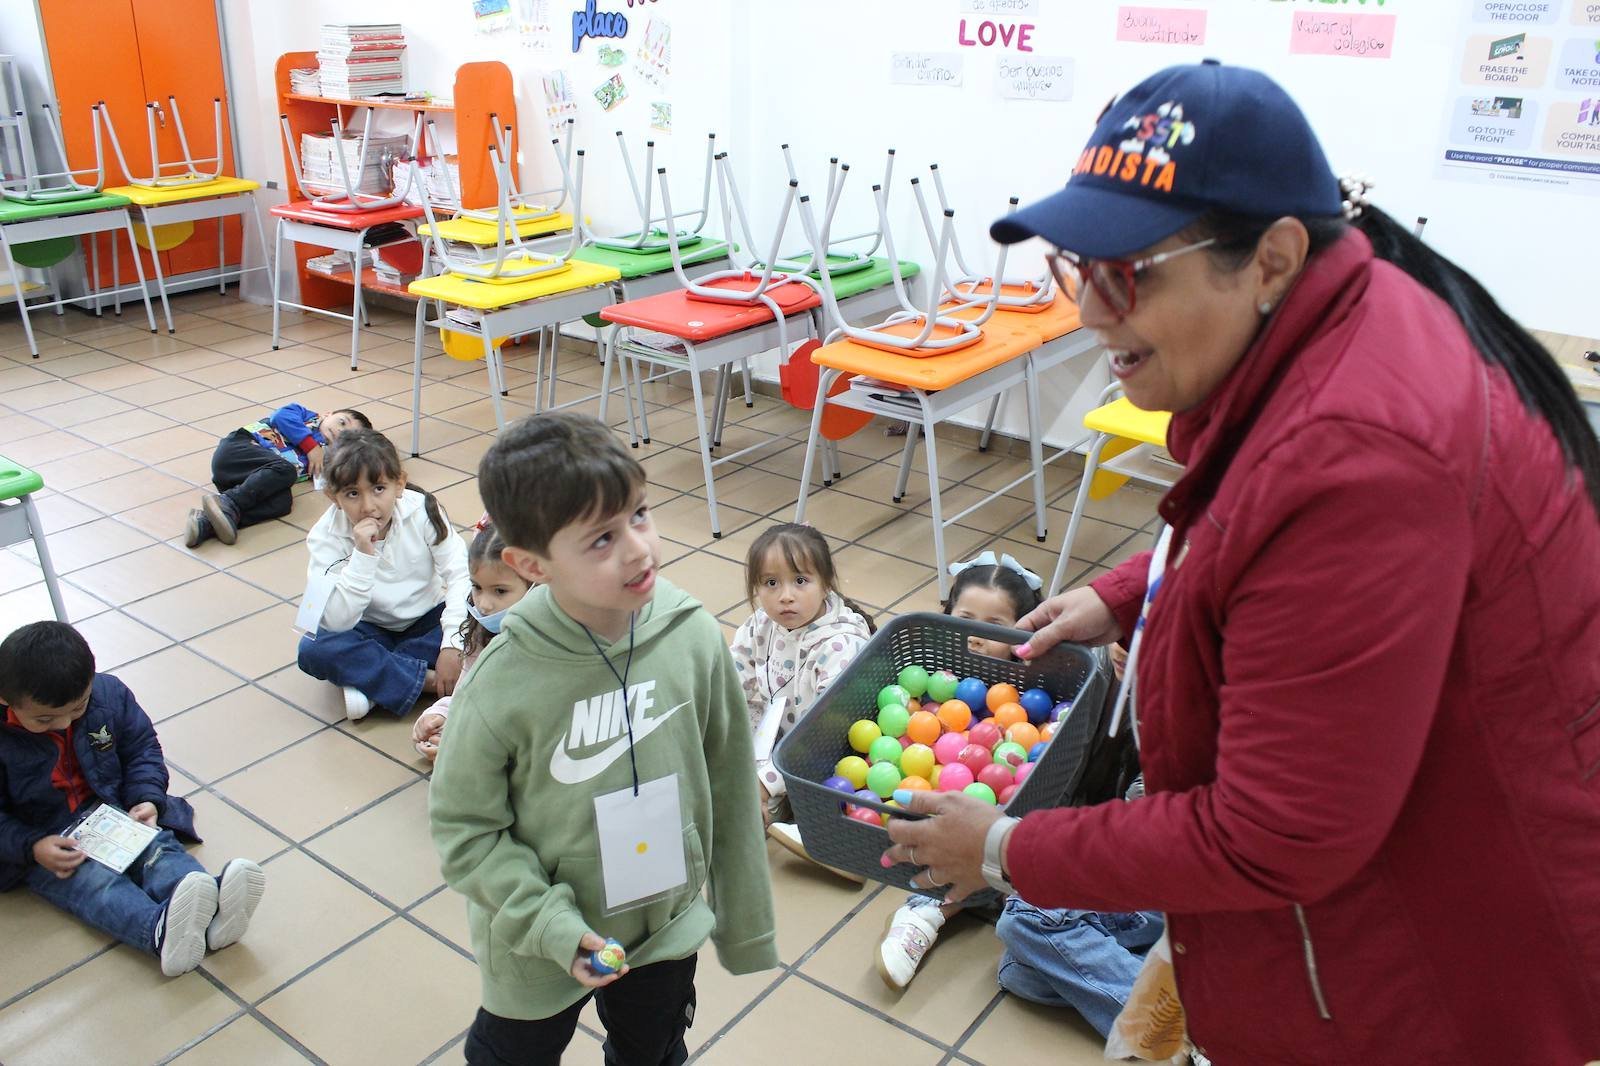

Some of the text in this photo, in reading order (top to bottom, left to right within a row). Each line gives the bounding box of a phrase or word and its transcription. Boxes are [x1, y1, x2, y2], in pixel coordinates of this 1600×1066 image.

[1485, 3, 1549, 12] OPEN/CLOSE
[1490, 12, 1539, 21] THE DOOR
[571, 0, 627, 52] place
[958, 19, 1035, 52] LOVE
[1334, 34, 1378, 54] colegio
[1000, 59, 1022, 79] Ser
[1480, 65, 1528, 74] ERASE THE
[1564, 68, 1600, 77] TAKE O
[1485, 73, 1519, 82] BOARD
[1572, 78, 1600, 86] NOTE
[1136, 114, 1184, 149] SST
[1468, 126, 1516, 136] GO TO THE
[1474, 135, 1505, 144] FRONT
[1556, 140, 1583, 149] YOUR
[1464, 153, 1475, 161] the
[1475, 154, 1493, 162] word
[1528, 159, 1538, 167] for
[1538, 160, 1563, 169] proper
[568, 680, 656, 750] NIKE
